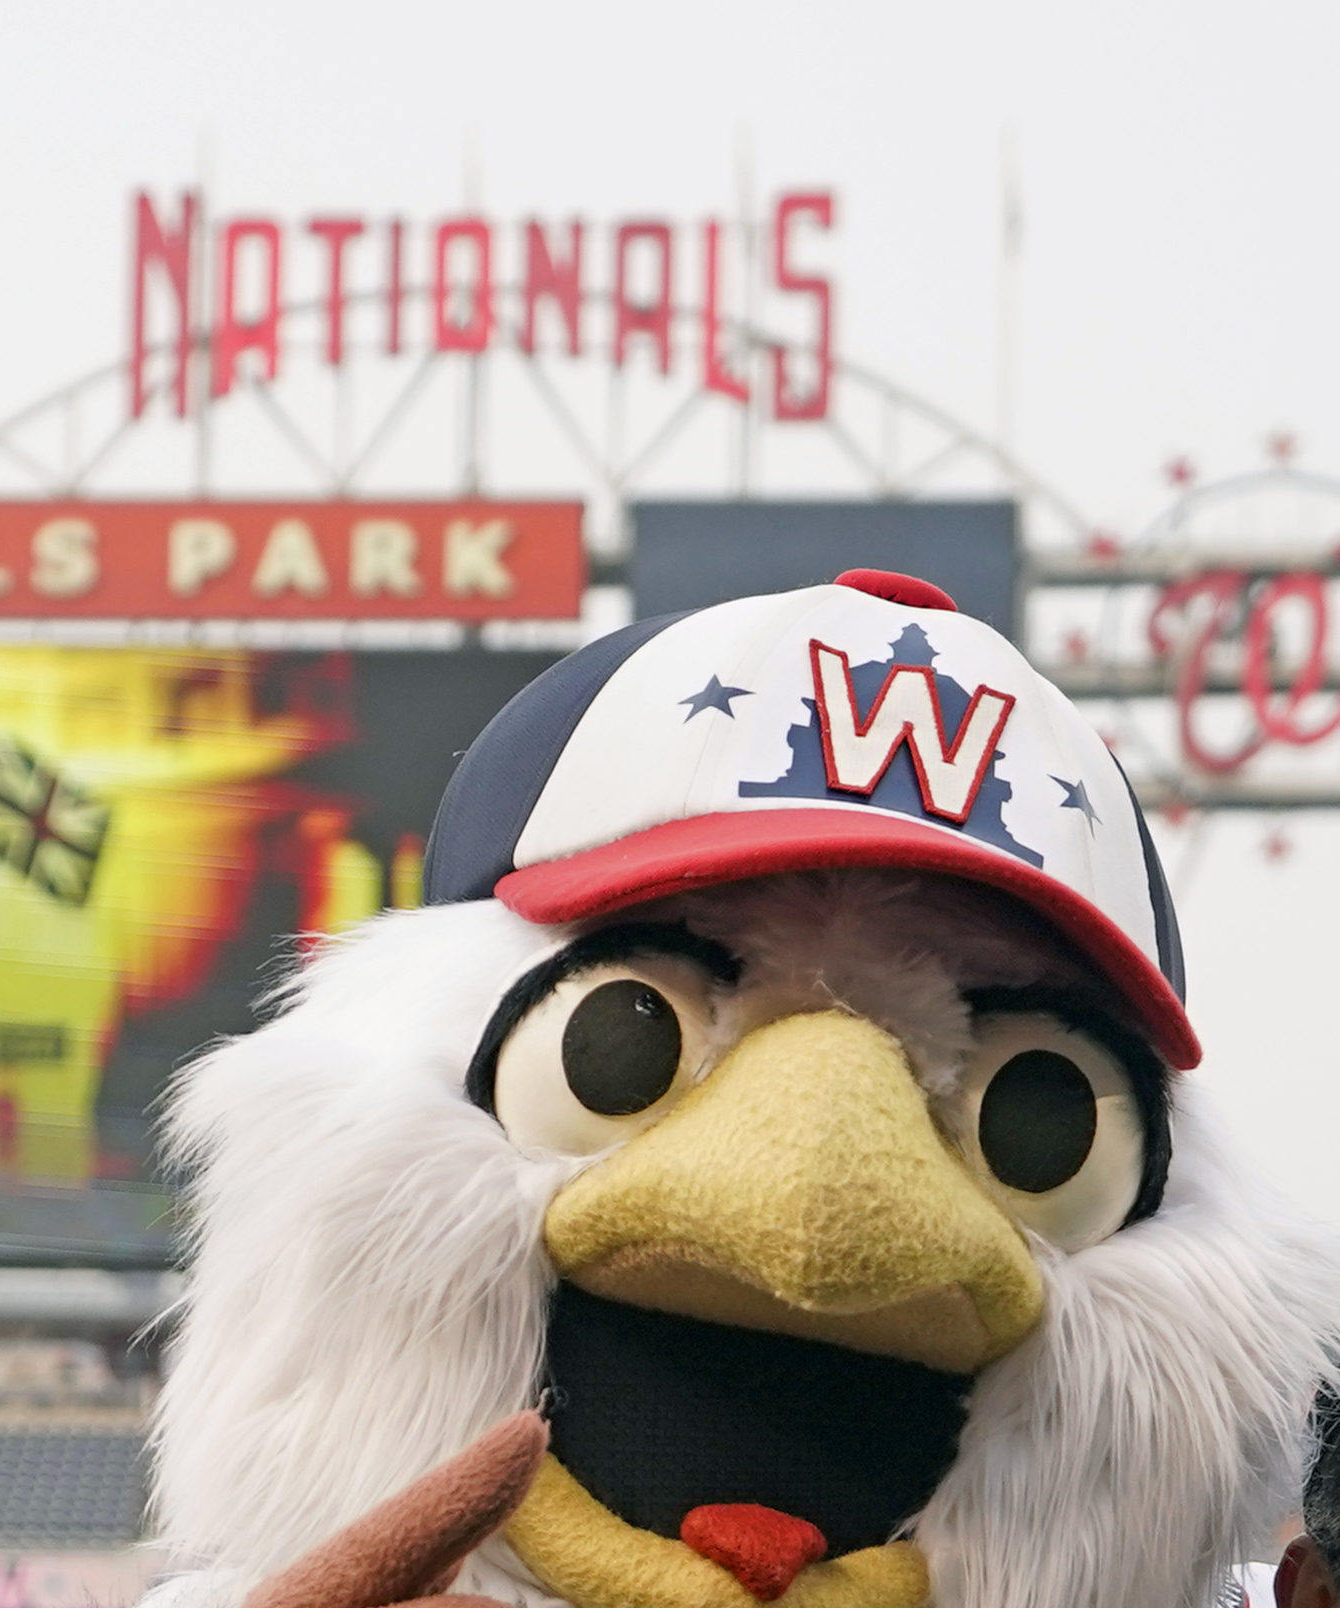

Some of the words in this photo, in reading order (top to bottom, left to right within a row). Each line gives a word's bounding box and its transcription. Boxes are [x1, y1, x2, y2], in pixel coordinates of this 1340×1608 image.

[131, 187, 837, 422] NATIONALS
[167, 515, 517, 598] PARK
[809, 638, 1017, 824] W
